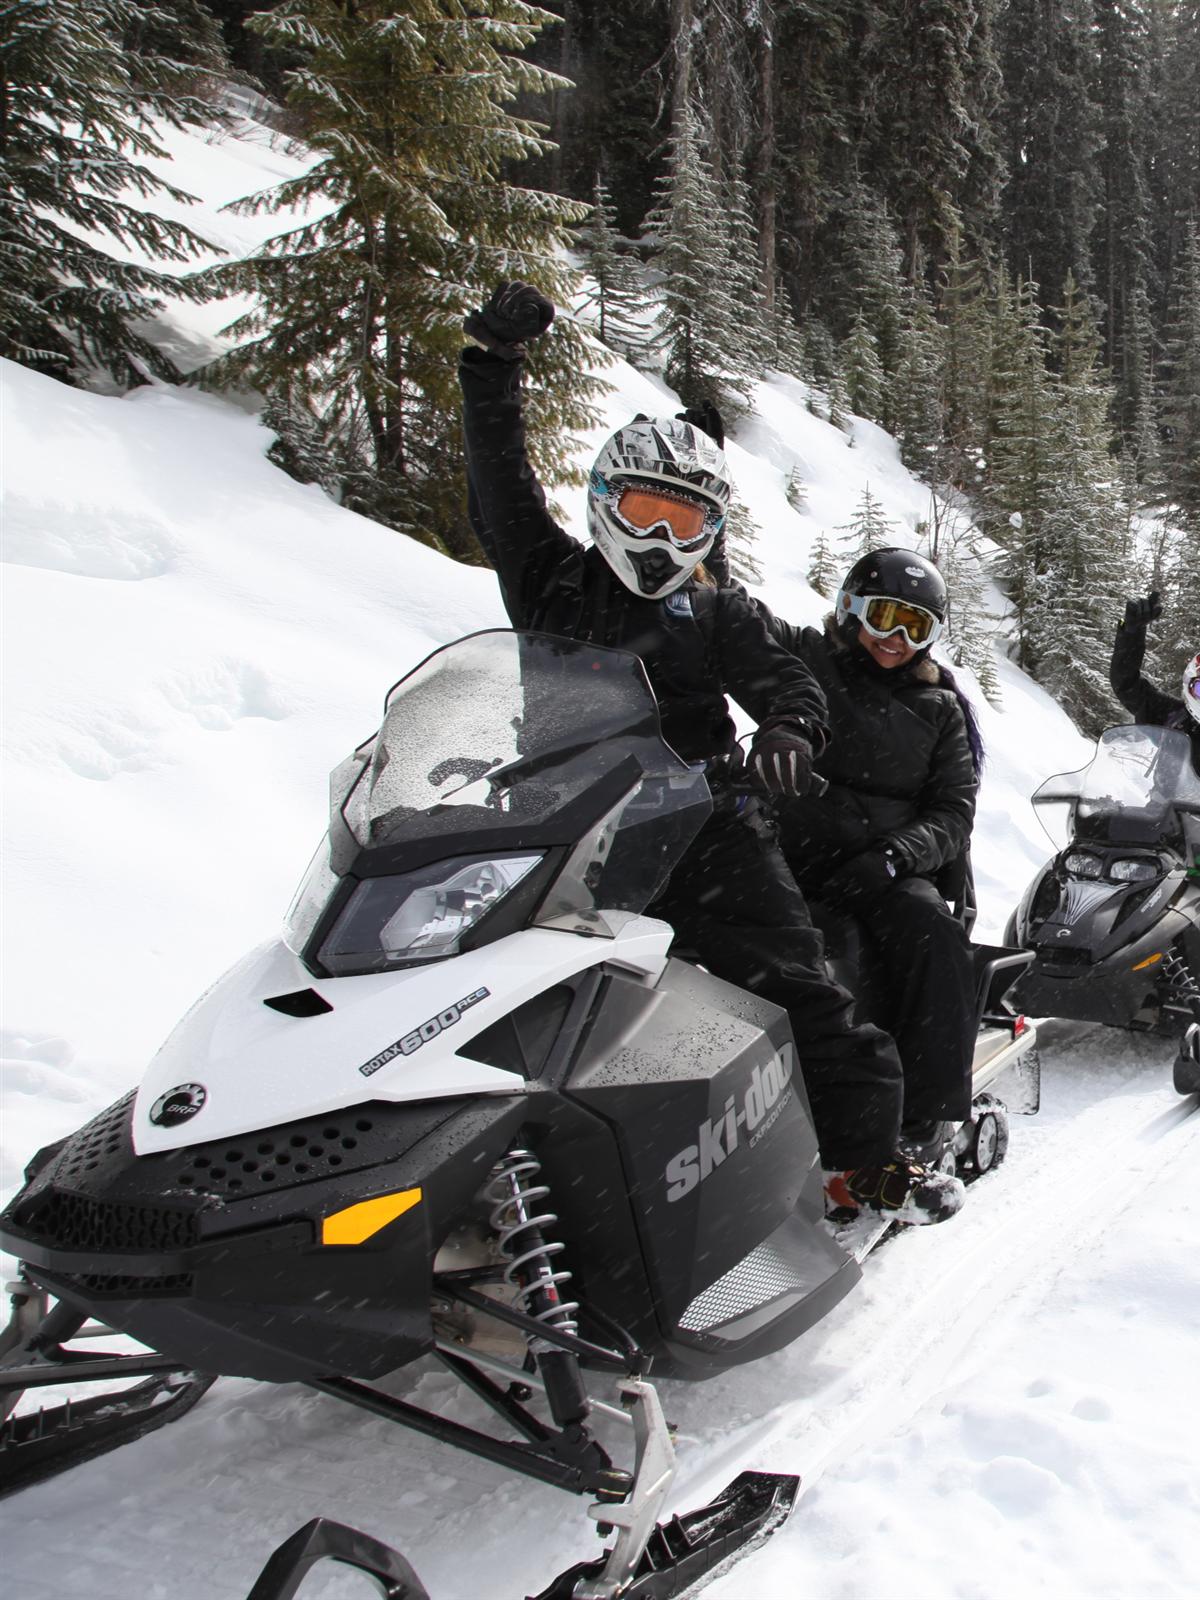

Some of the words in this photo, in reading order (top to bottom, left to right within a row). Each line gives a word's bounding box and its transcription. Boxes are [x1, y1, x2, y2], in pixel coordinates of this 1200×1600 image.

[361, 1044, 401, 1076] ROTAX
[400, 1006, 460, 1056] 600
[166, 1104, 198, 1115] BRP
[750, 1089, 792, 1149] EXPEDITION
